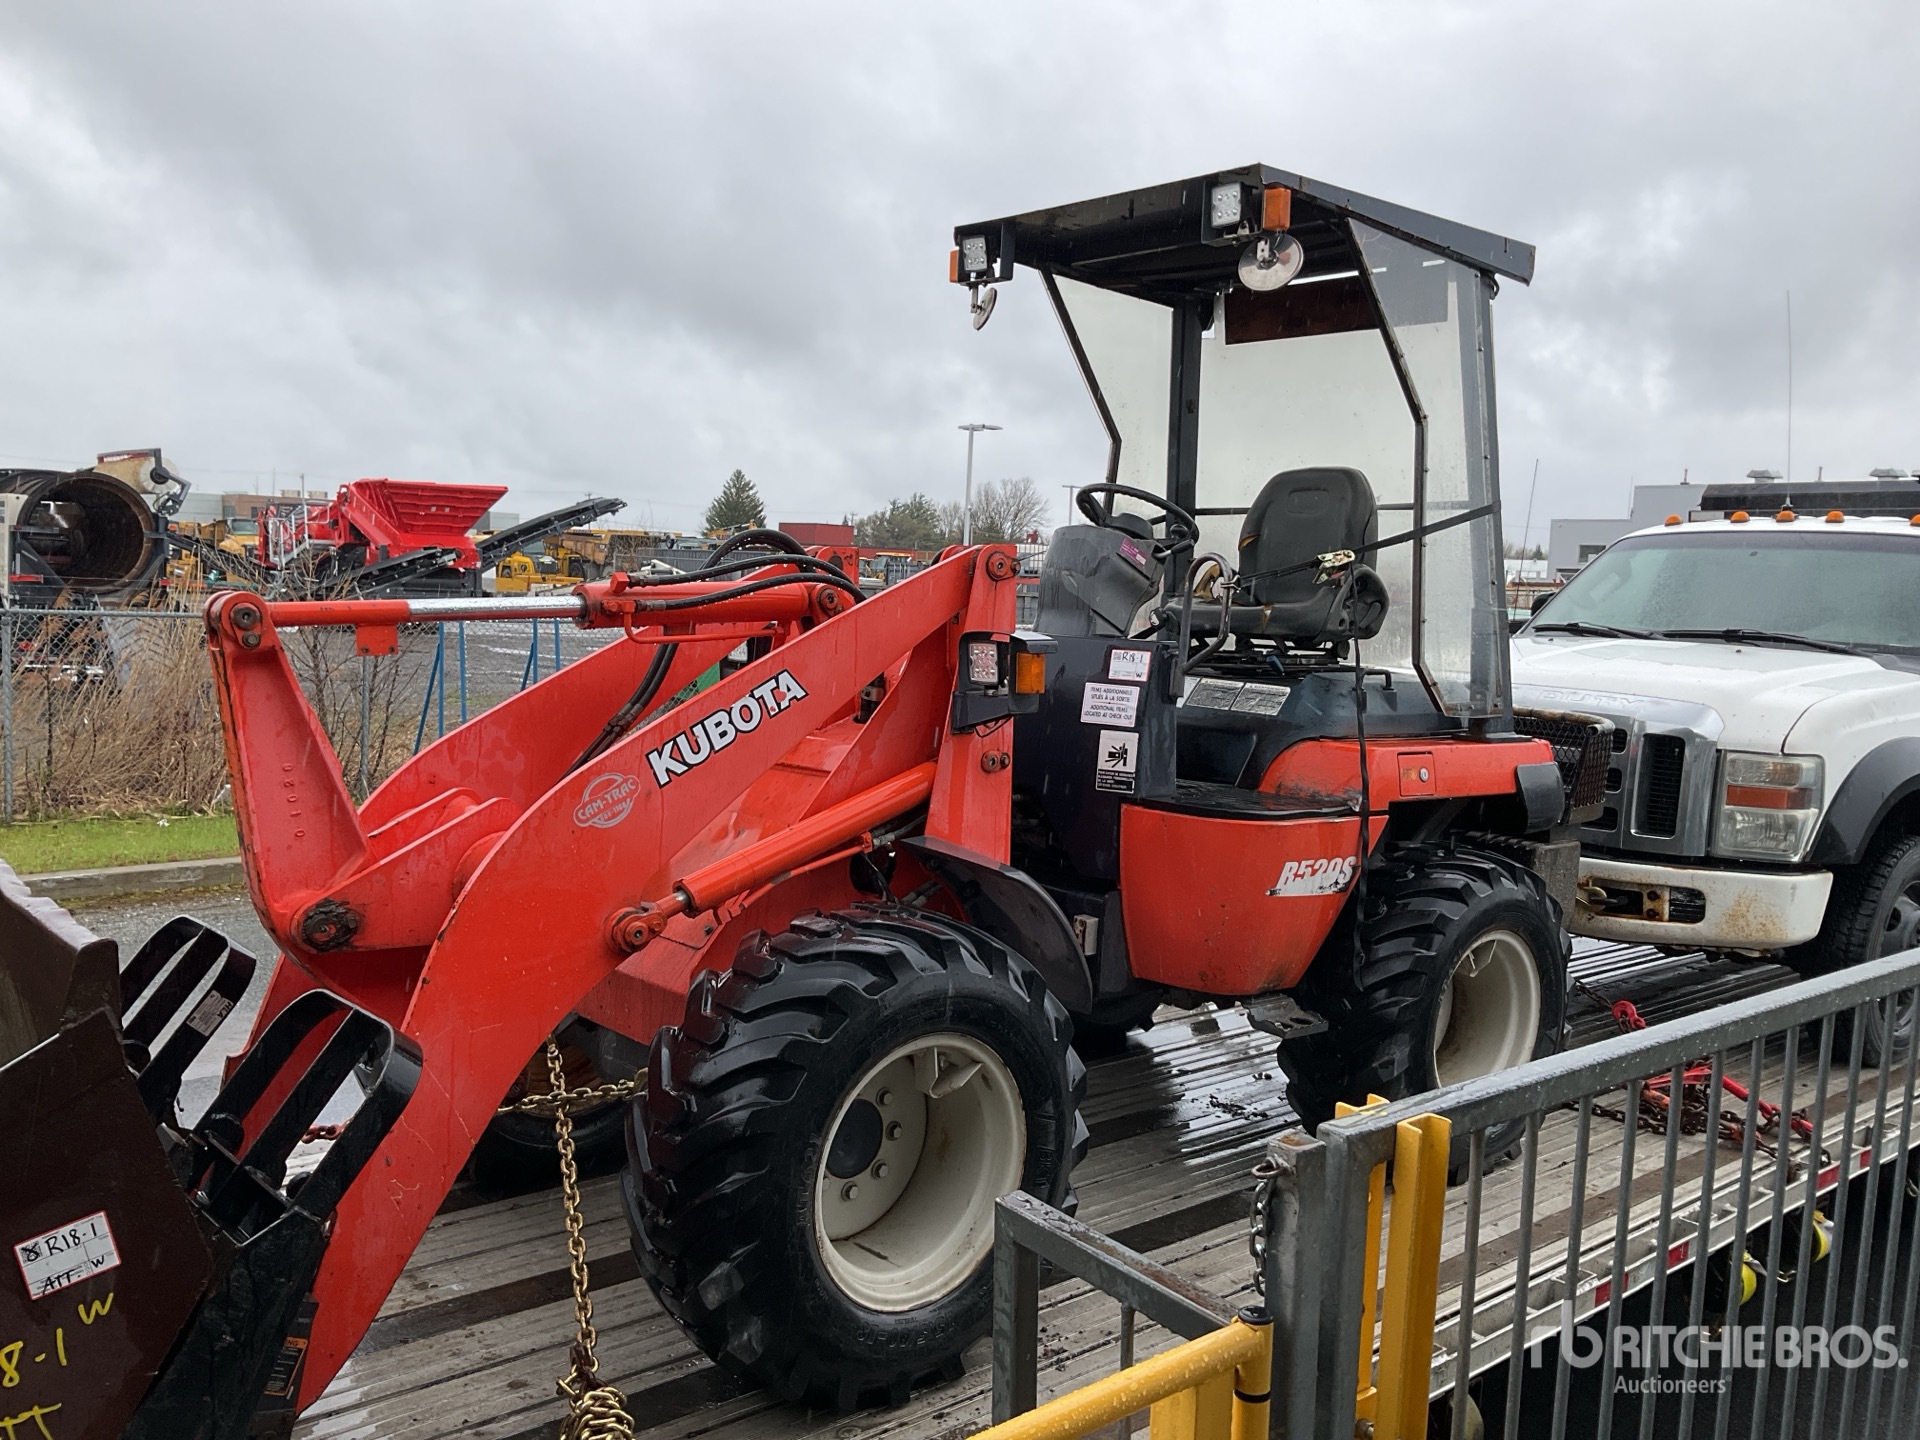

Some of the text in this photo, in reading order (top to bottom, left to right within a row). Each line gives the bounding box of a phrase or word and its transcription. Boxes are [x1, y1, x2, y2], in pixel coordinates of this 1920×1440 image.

[1536, 690, 1646, 712] DUTY
[645, 668, 809, 788] KUBOTA
[577, 778, 636, 820] CAM-TRAC
[1276, 855, 1357, 888] R520S
[44, 1222, 97, 1256] R18-1
[91, 1256, 104, 1268] W
[78, 1292, 114, 1325] W
